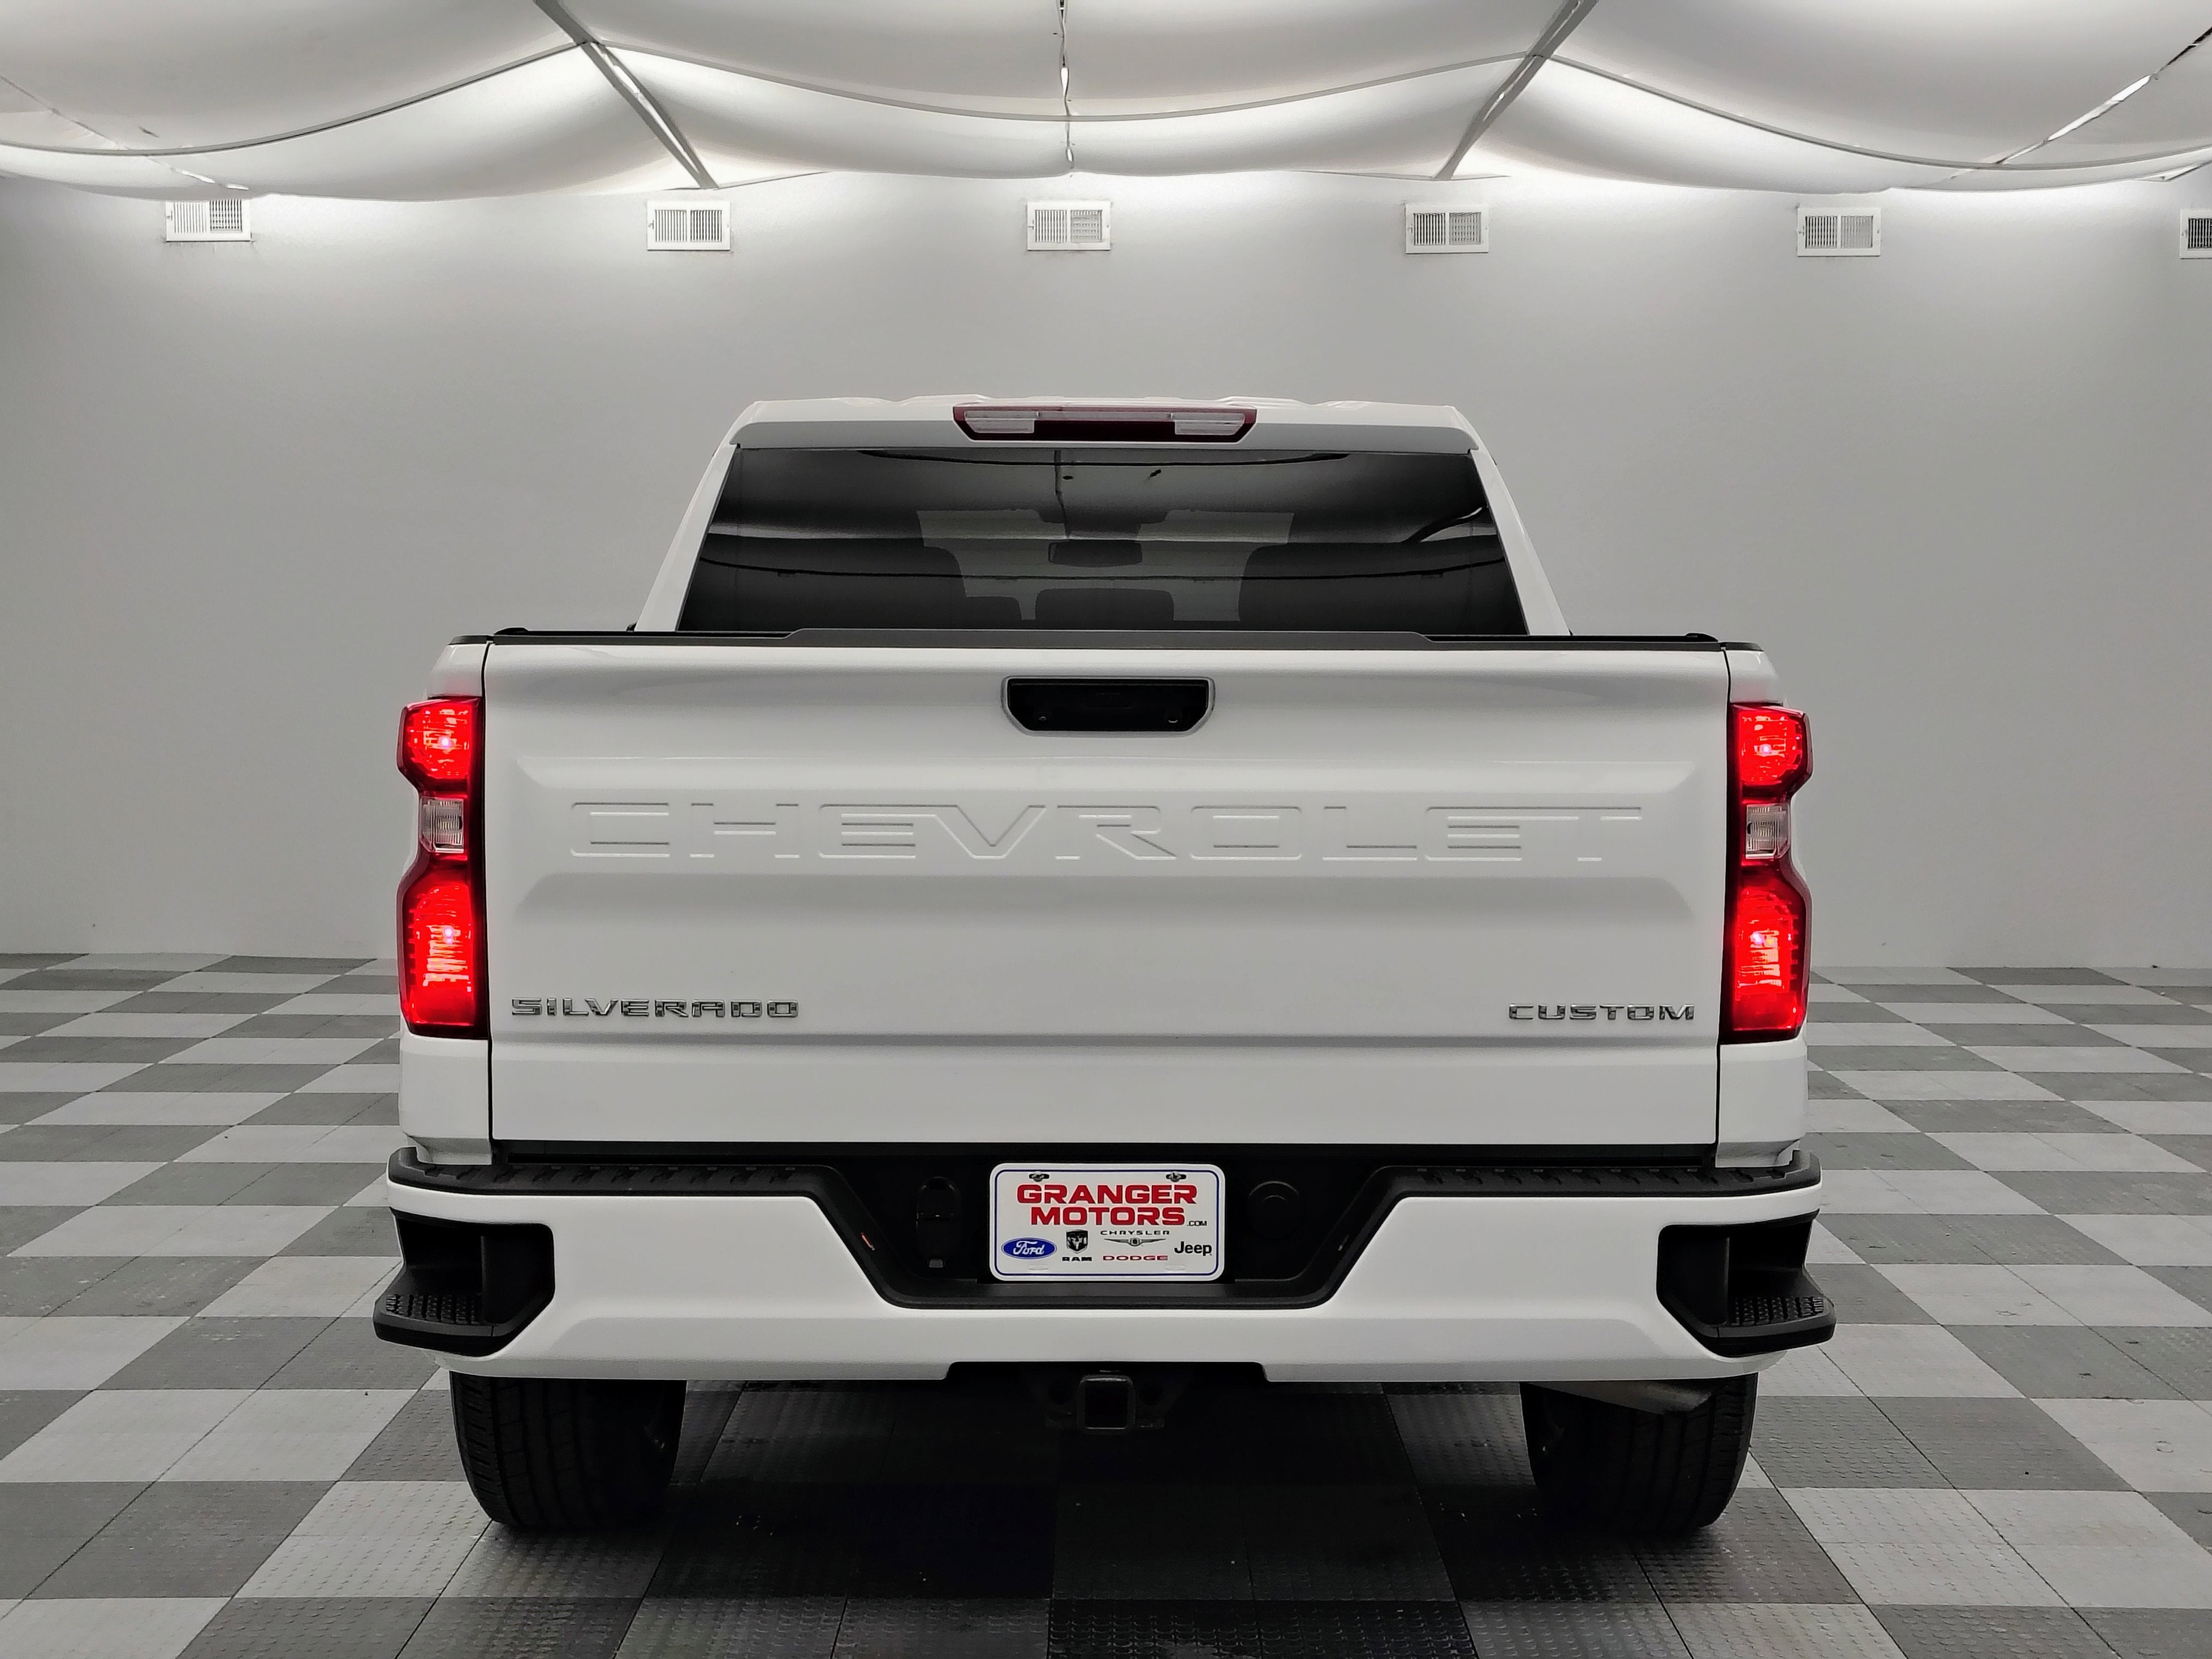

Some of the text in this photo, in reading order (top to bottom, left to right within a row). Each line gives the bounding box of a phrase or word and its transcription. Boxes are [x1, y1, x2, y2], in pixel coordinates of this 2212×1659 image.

[571, 802, 1642, 861] CHEVROLET
[511, 997, 799, 1017] SILVERADO
[1509, 1003, 1695, 1020] CUSTOM
[1016, 1184, 1197, 1204] GRANGER
[1030, 1206, 1185, 1226] MOTORS
[1013, 1241, 1045, 1255] Ford
[1174, 1241, 1212, 1256] Jeep
